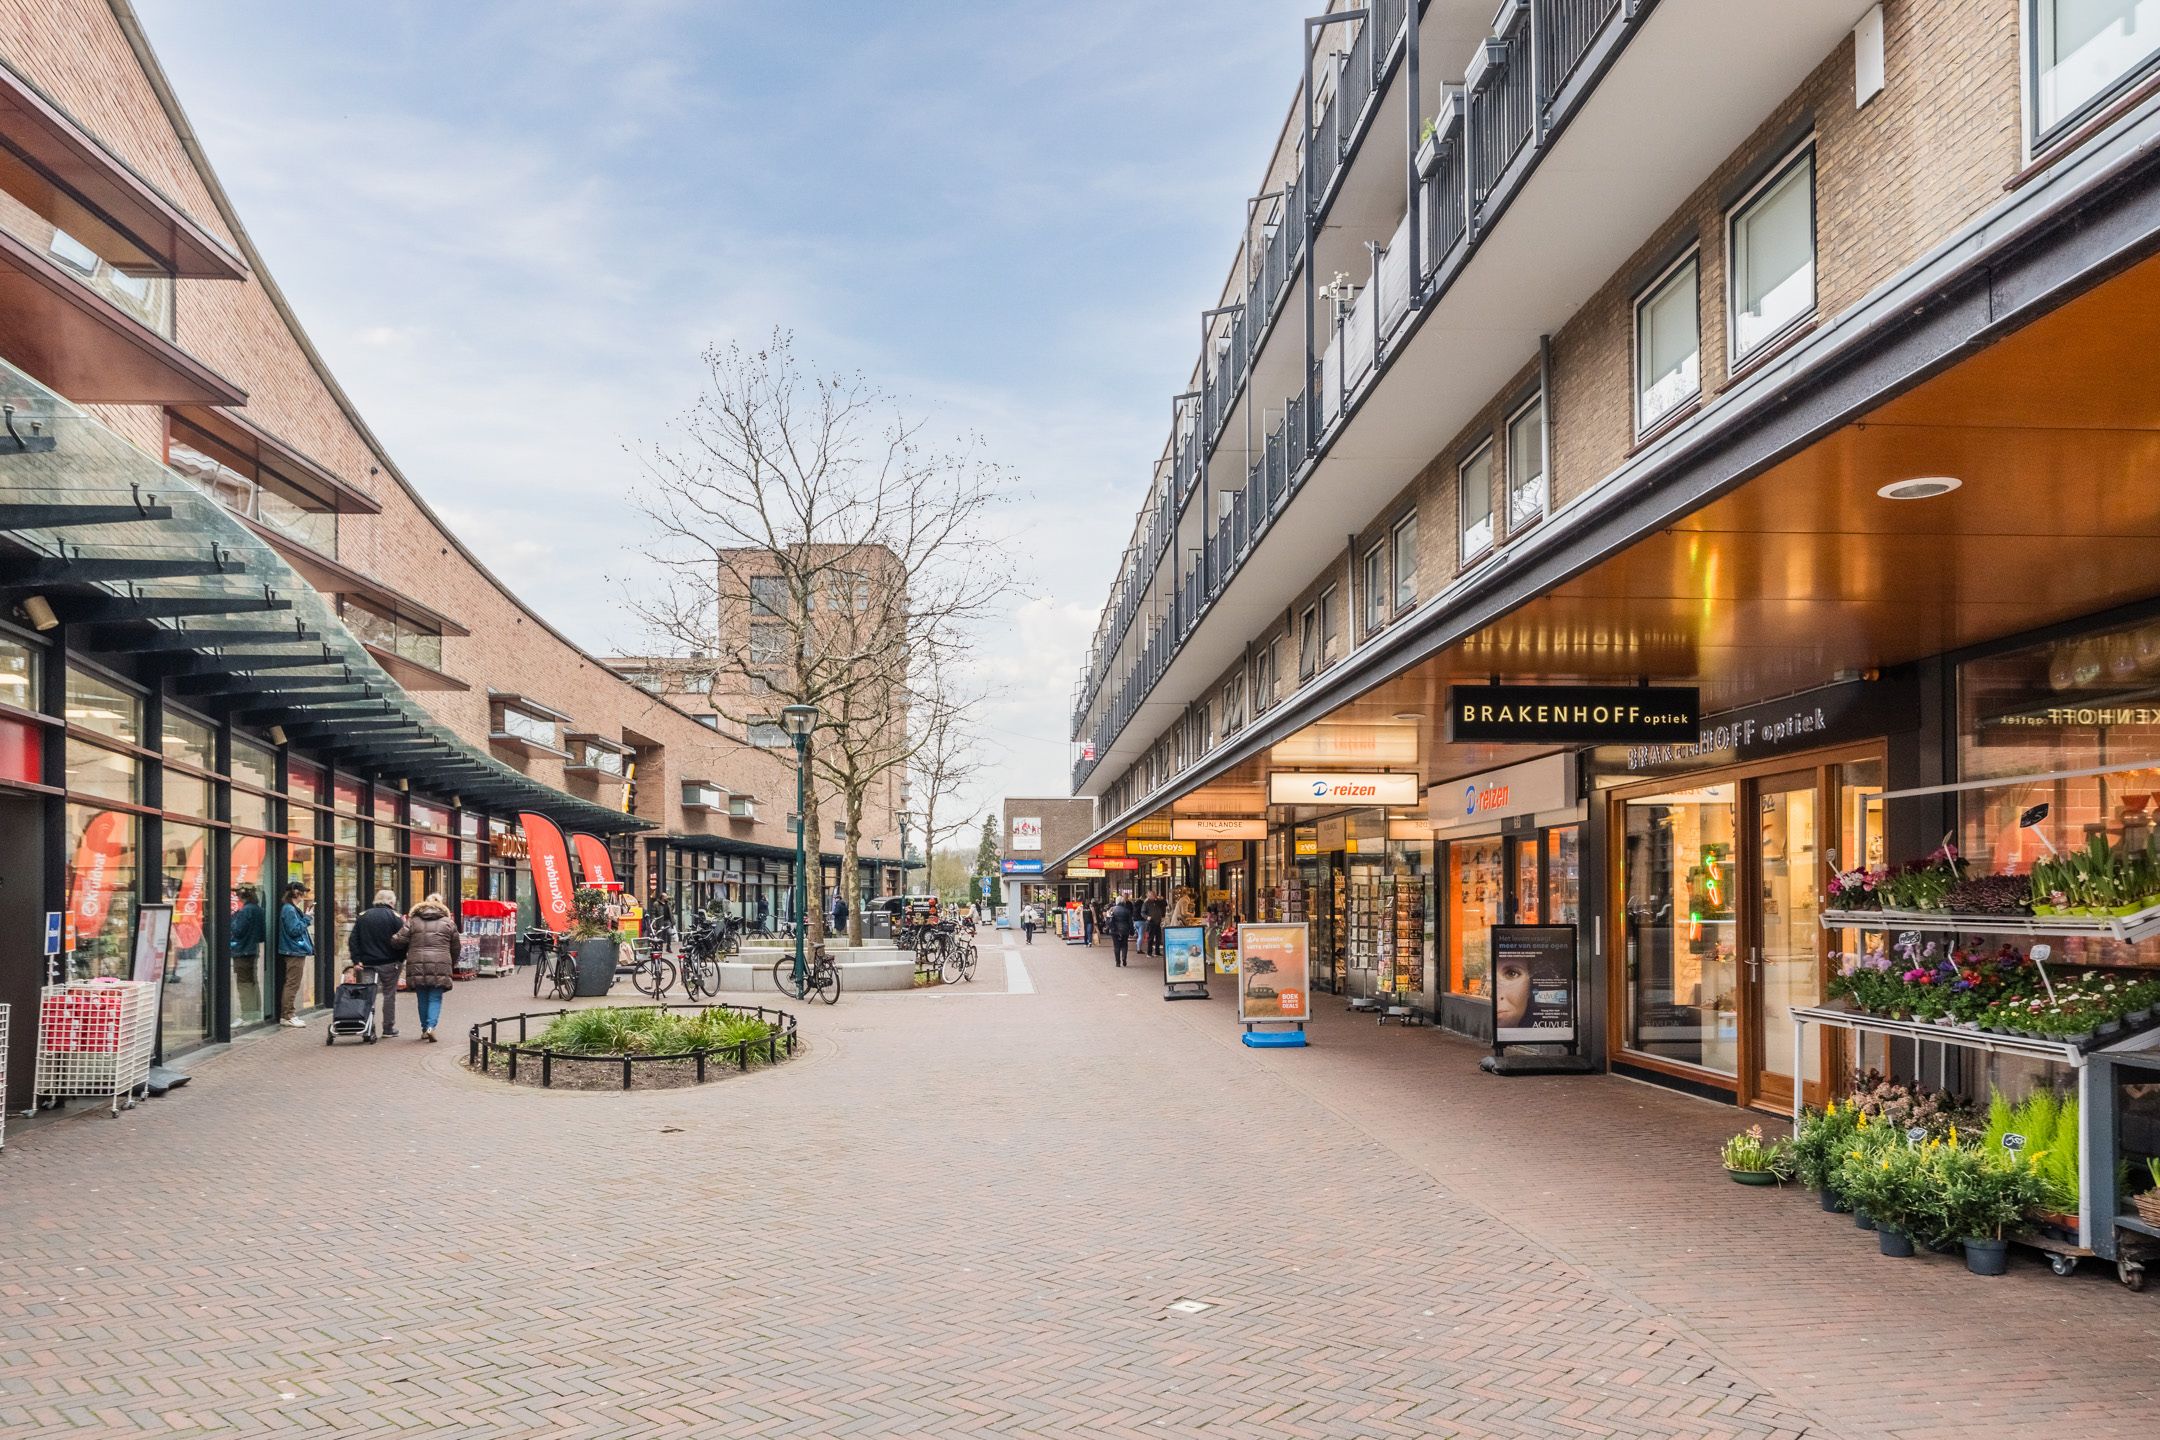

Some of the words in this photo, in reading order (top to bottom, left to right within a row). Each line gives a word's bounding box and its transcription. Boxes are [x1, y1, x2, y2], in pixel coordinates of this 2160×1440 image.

[1463, 705, 1640, 723] BRAKENHOFF
[1644, 713, 1688, 725] optiek
[1762, 708, 1826, 744] optiek
[1312, 781, 1376, 797] D-reizen
[501, 834, 530, 859] ROOST
[1138, 842, 1183, 852] Intertoys
[1532, 1020, 1569, 1028] ACUVUE
